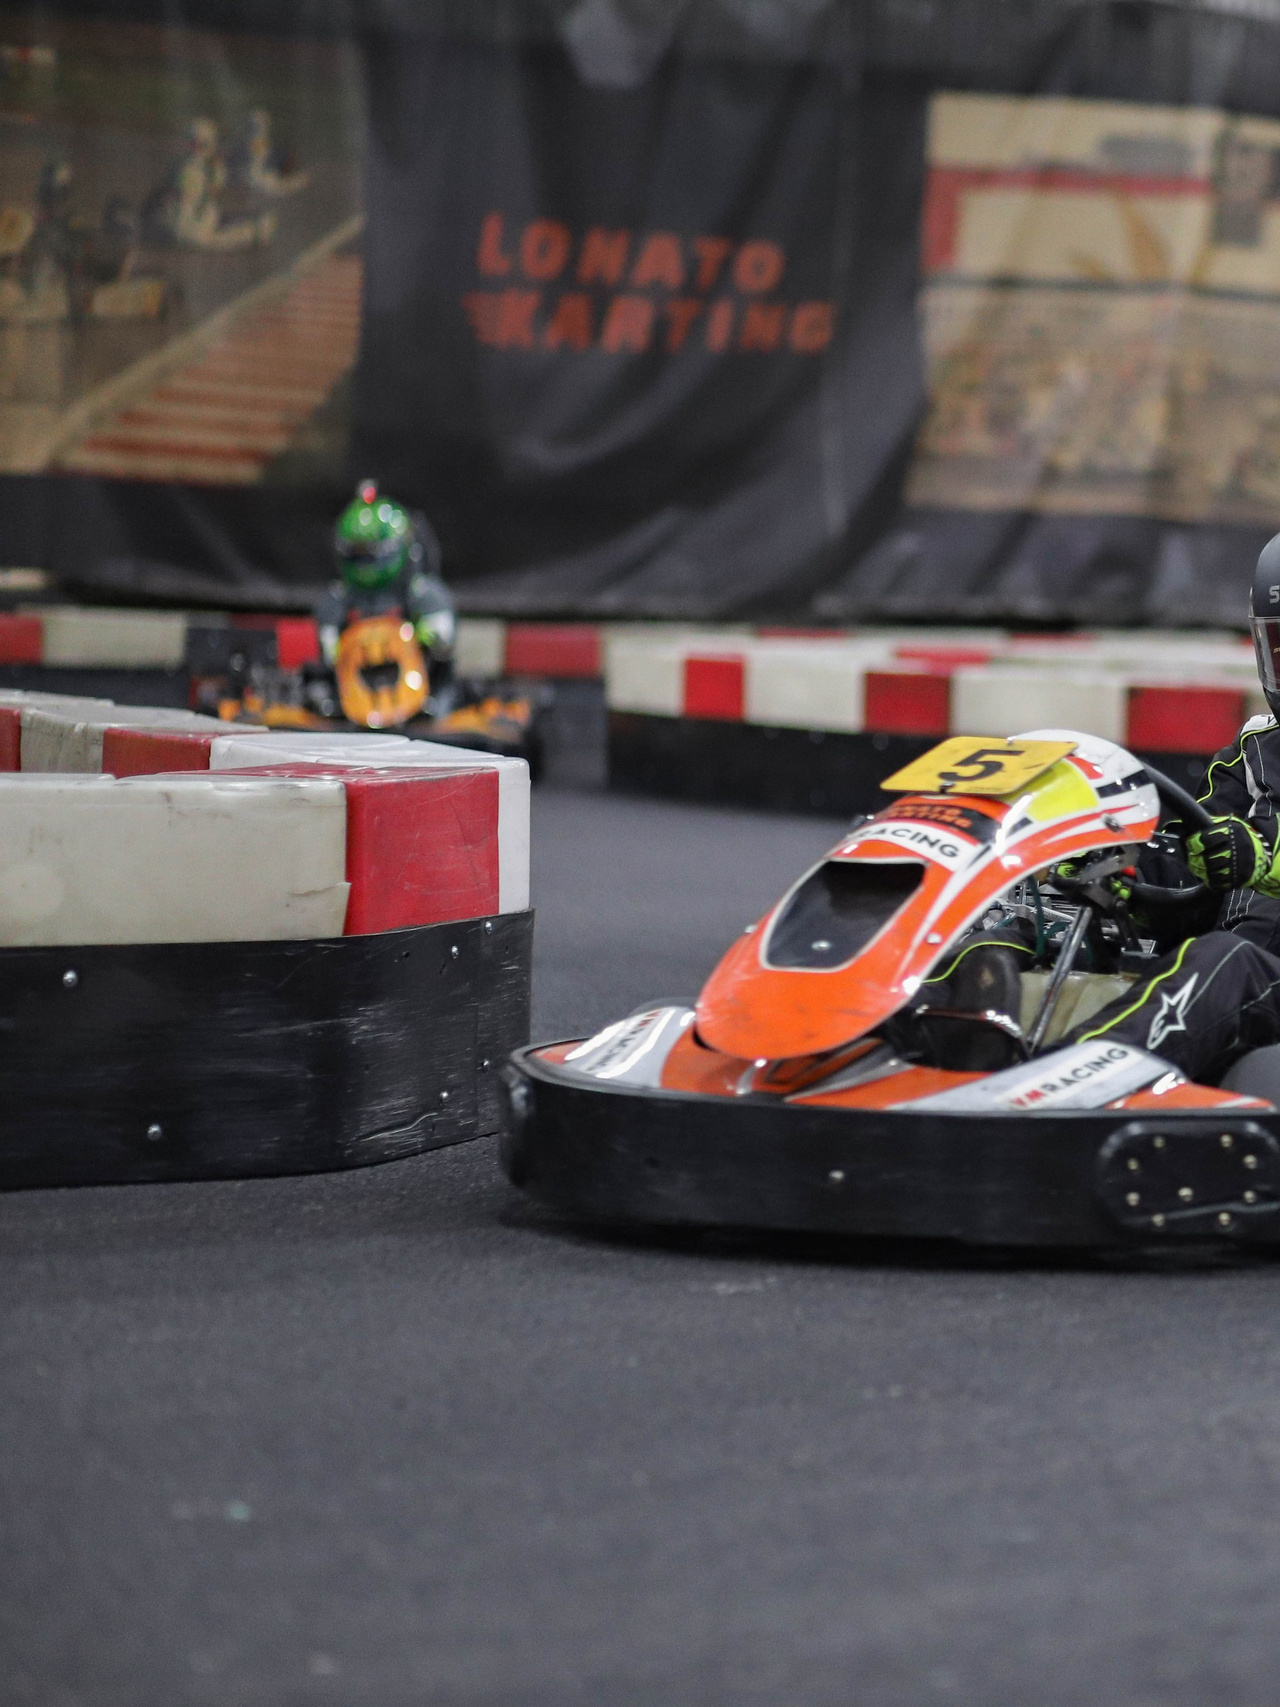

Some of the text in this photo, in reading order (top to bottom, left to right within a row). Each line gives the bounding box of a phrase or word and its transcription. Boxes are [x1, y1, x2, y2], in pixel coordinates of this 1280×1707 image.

[477, 211, 784, 295] LONATO
[464, 289, 834, 356] KARTING
[938, 749, 1025, 783] 5
